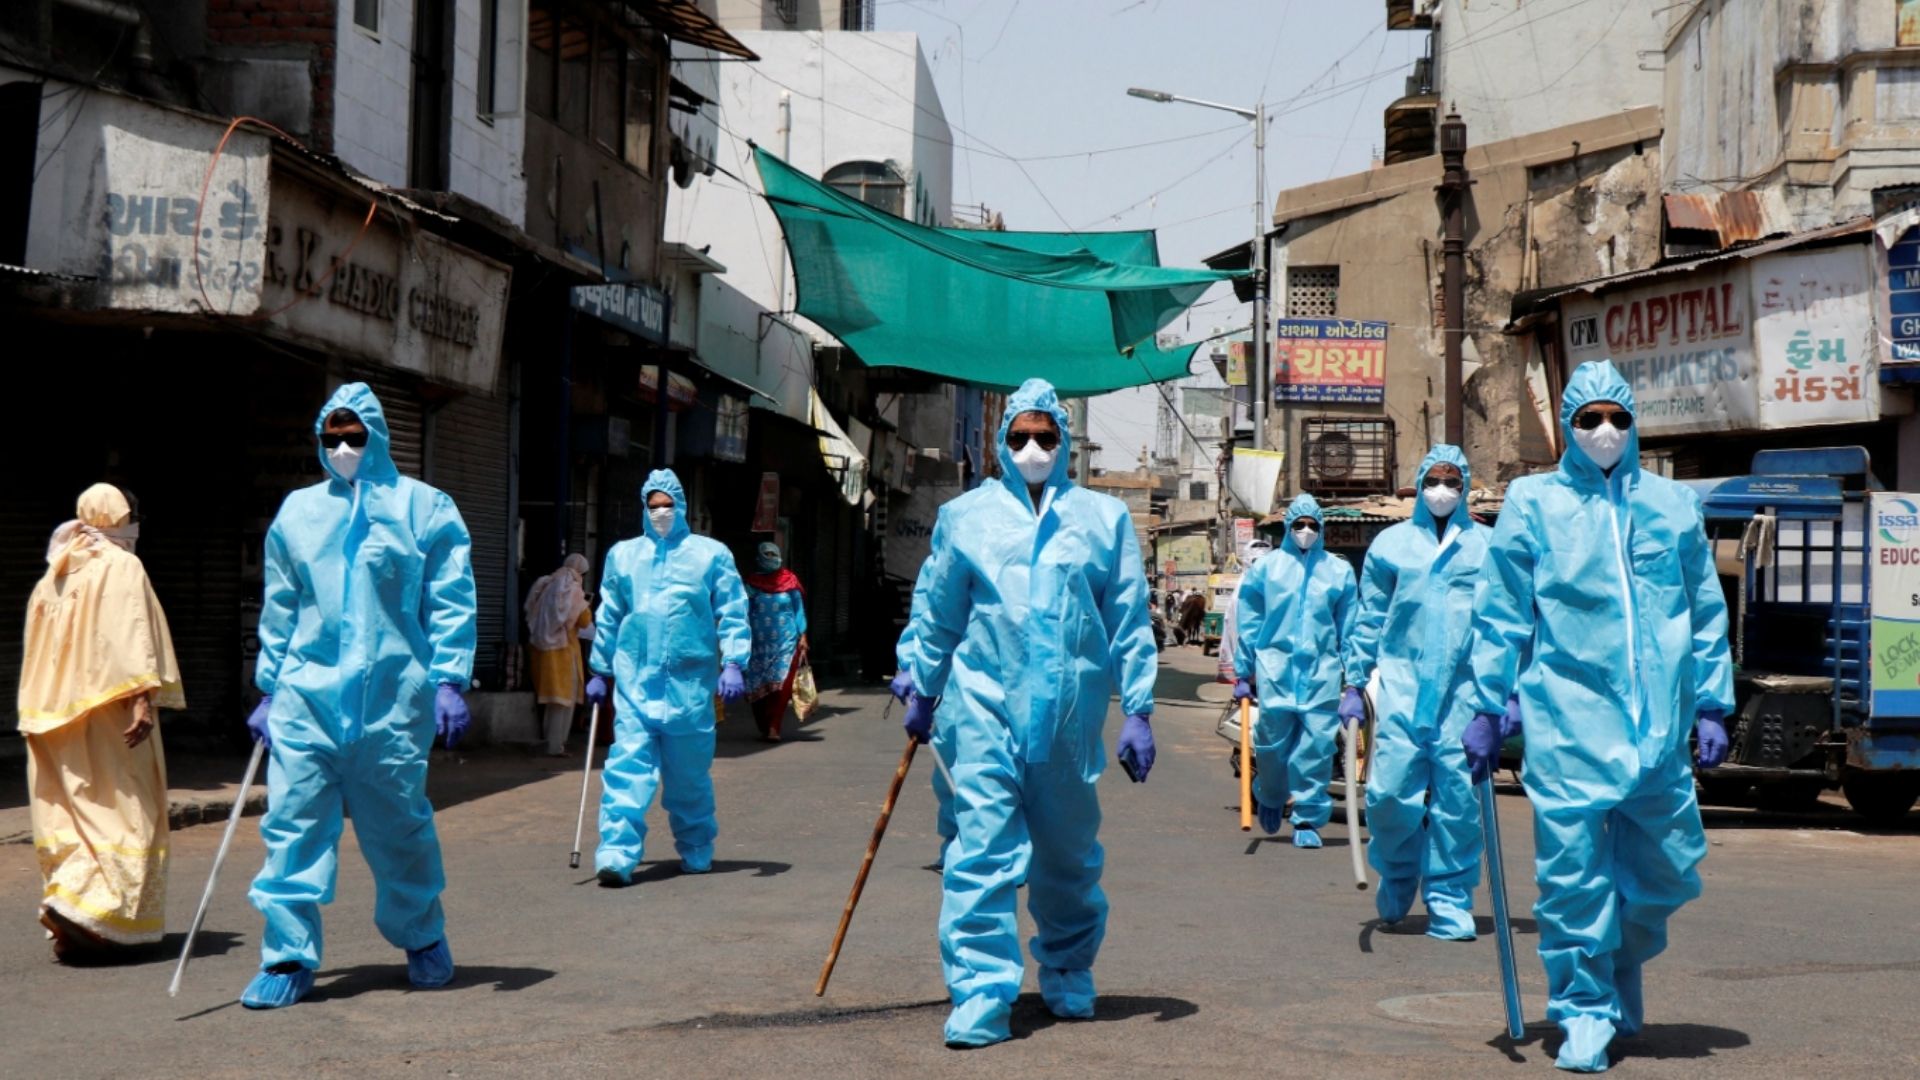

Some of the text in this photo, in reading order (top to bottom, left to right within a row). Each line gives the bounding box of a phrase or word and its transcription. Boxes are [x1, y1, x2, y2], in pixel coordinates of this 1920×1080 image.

[1605, 283, 1741, 352] CAPITAL
[1650, 347, 1738, 389] MAKERS
[1670, 396, 1704, 416] FRAME
[1879, 632, 1919, 666] LOCK
